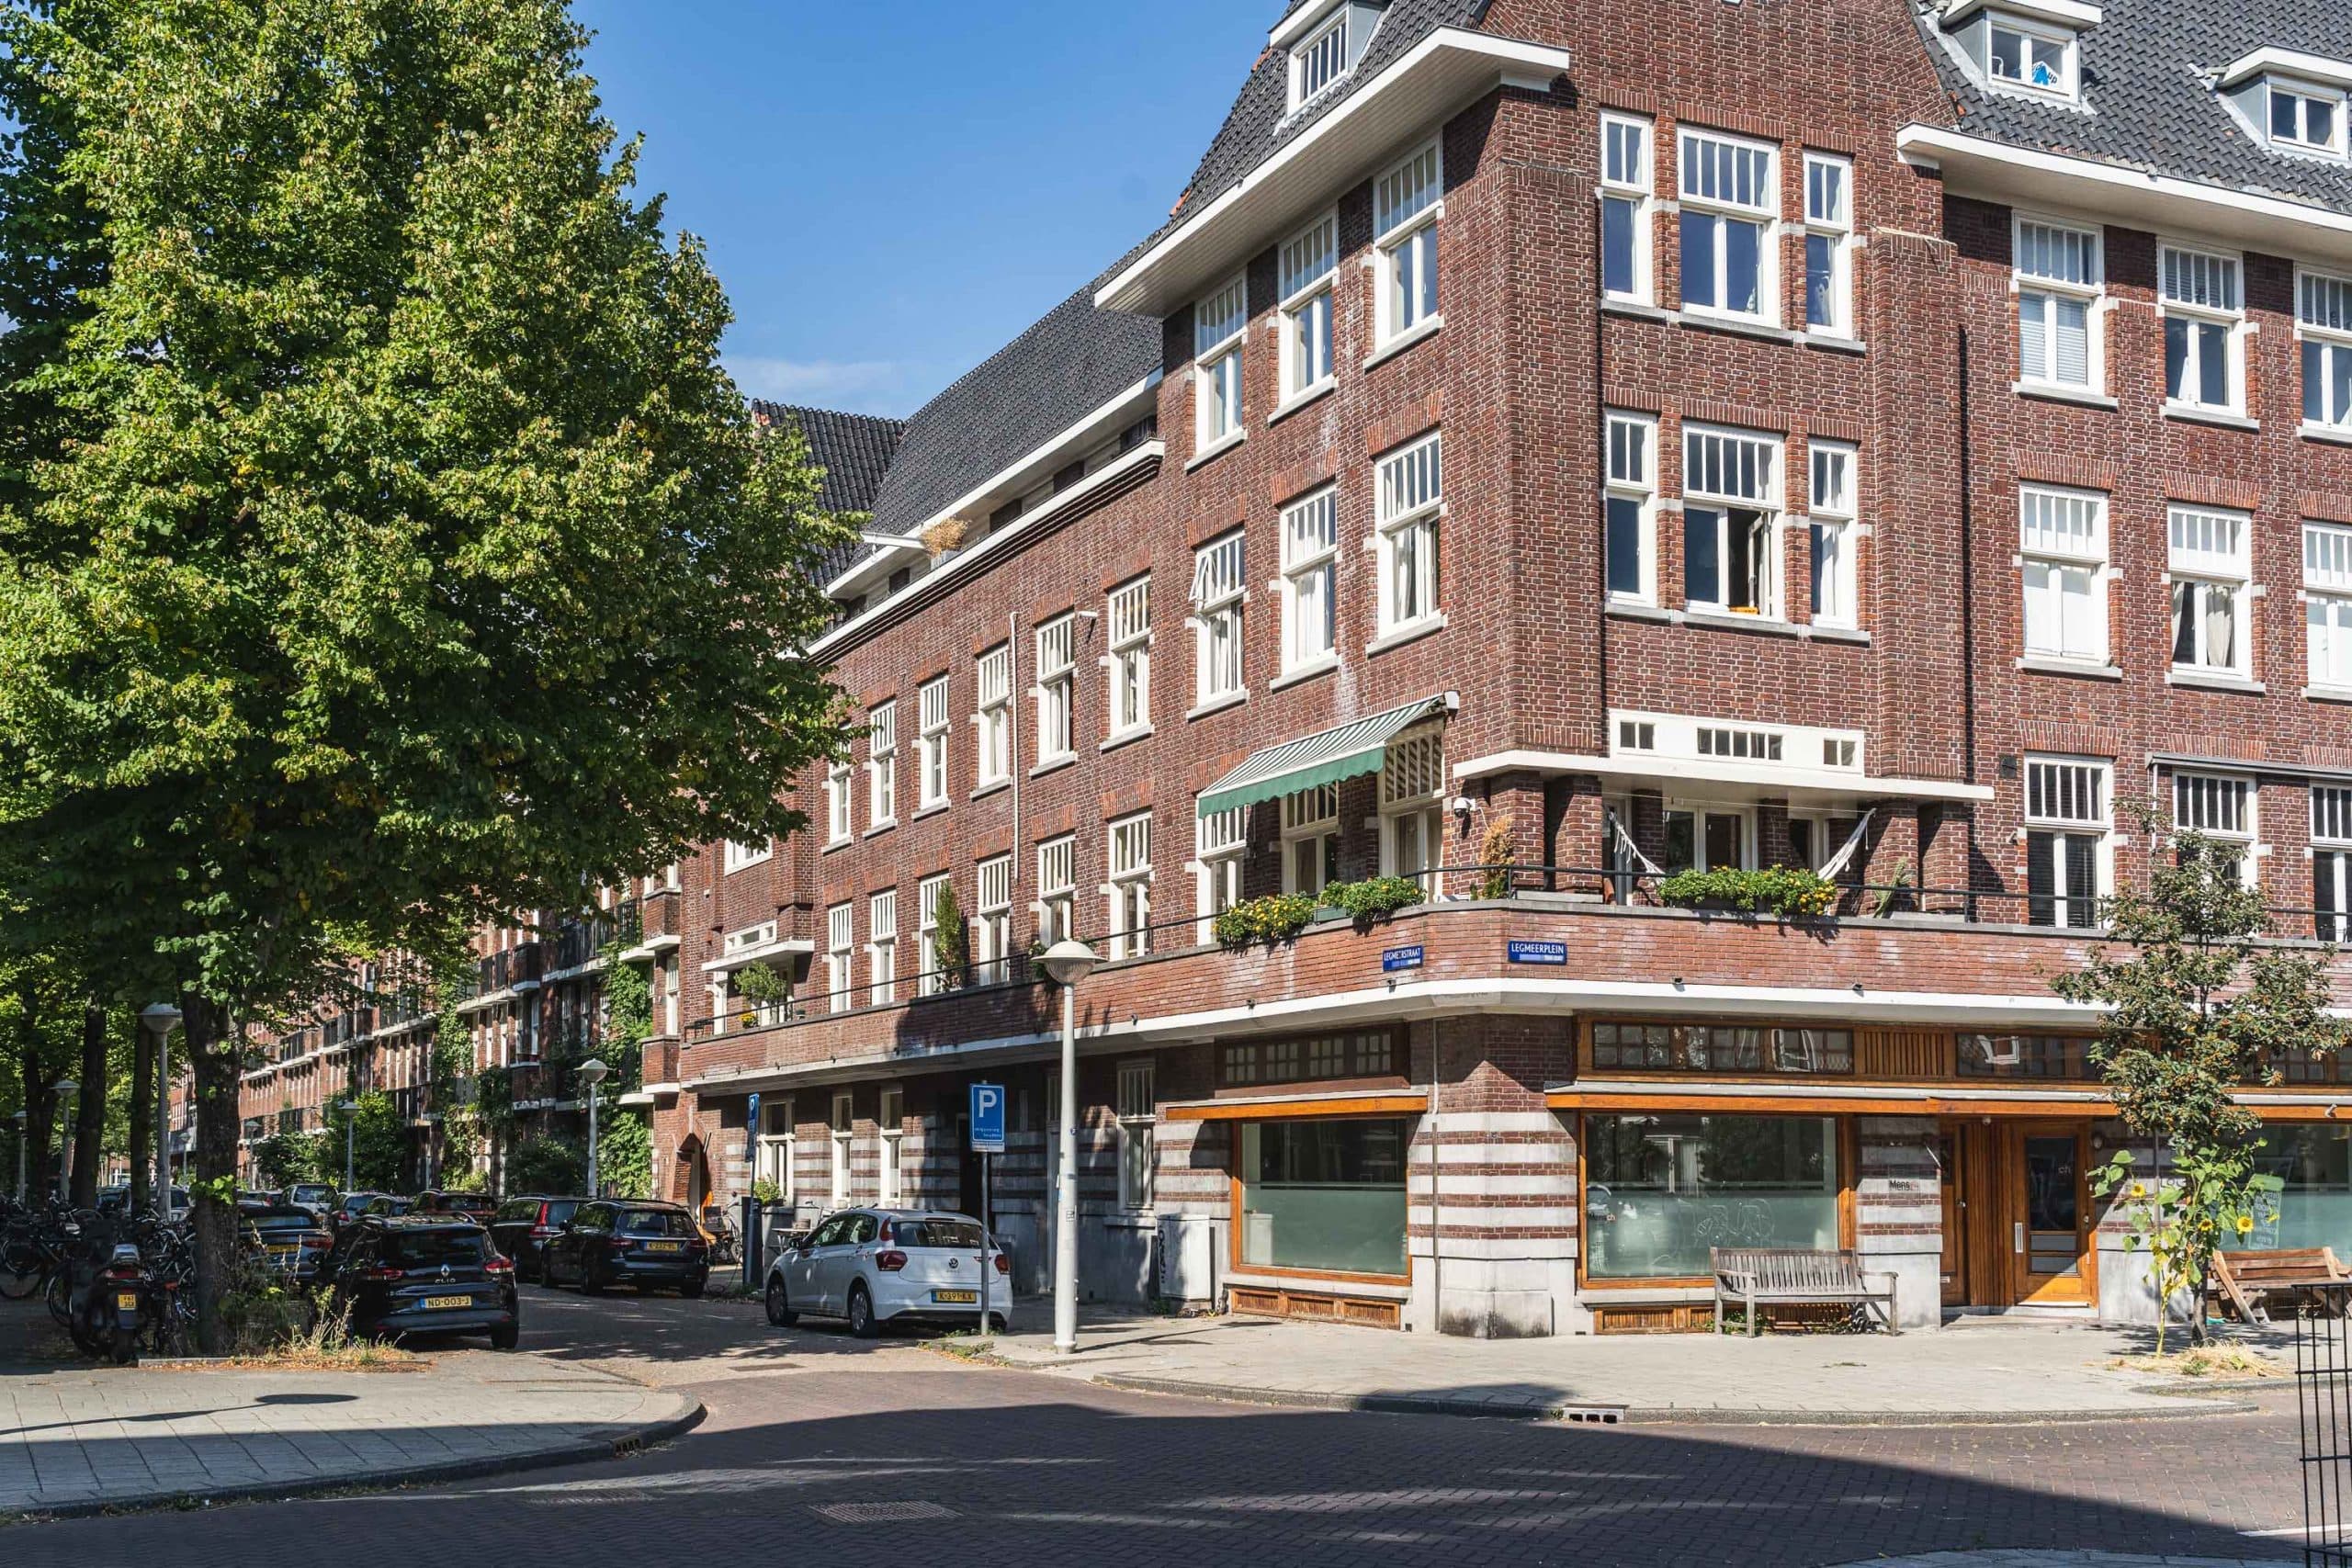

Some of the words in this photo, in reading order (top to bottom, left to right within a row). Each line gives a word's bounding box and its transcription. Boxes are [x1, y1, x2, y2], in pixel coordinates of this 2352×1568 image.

[1511, 942, 1564, 954] LEGMEERPLEIN
[978, 1089, 997, 1117] P
[427, 1297, 469, 1307] ND-003-J
